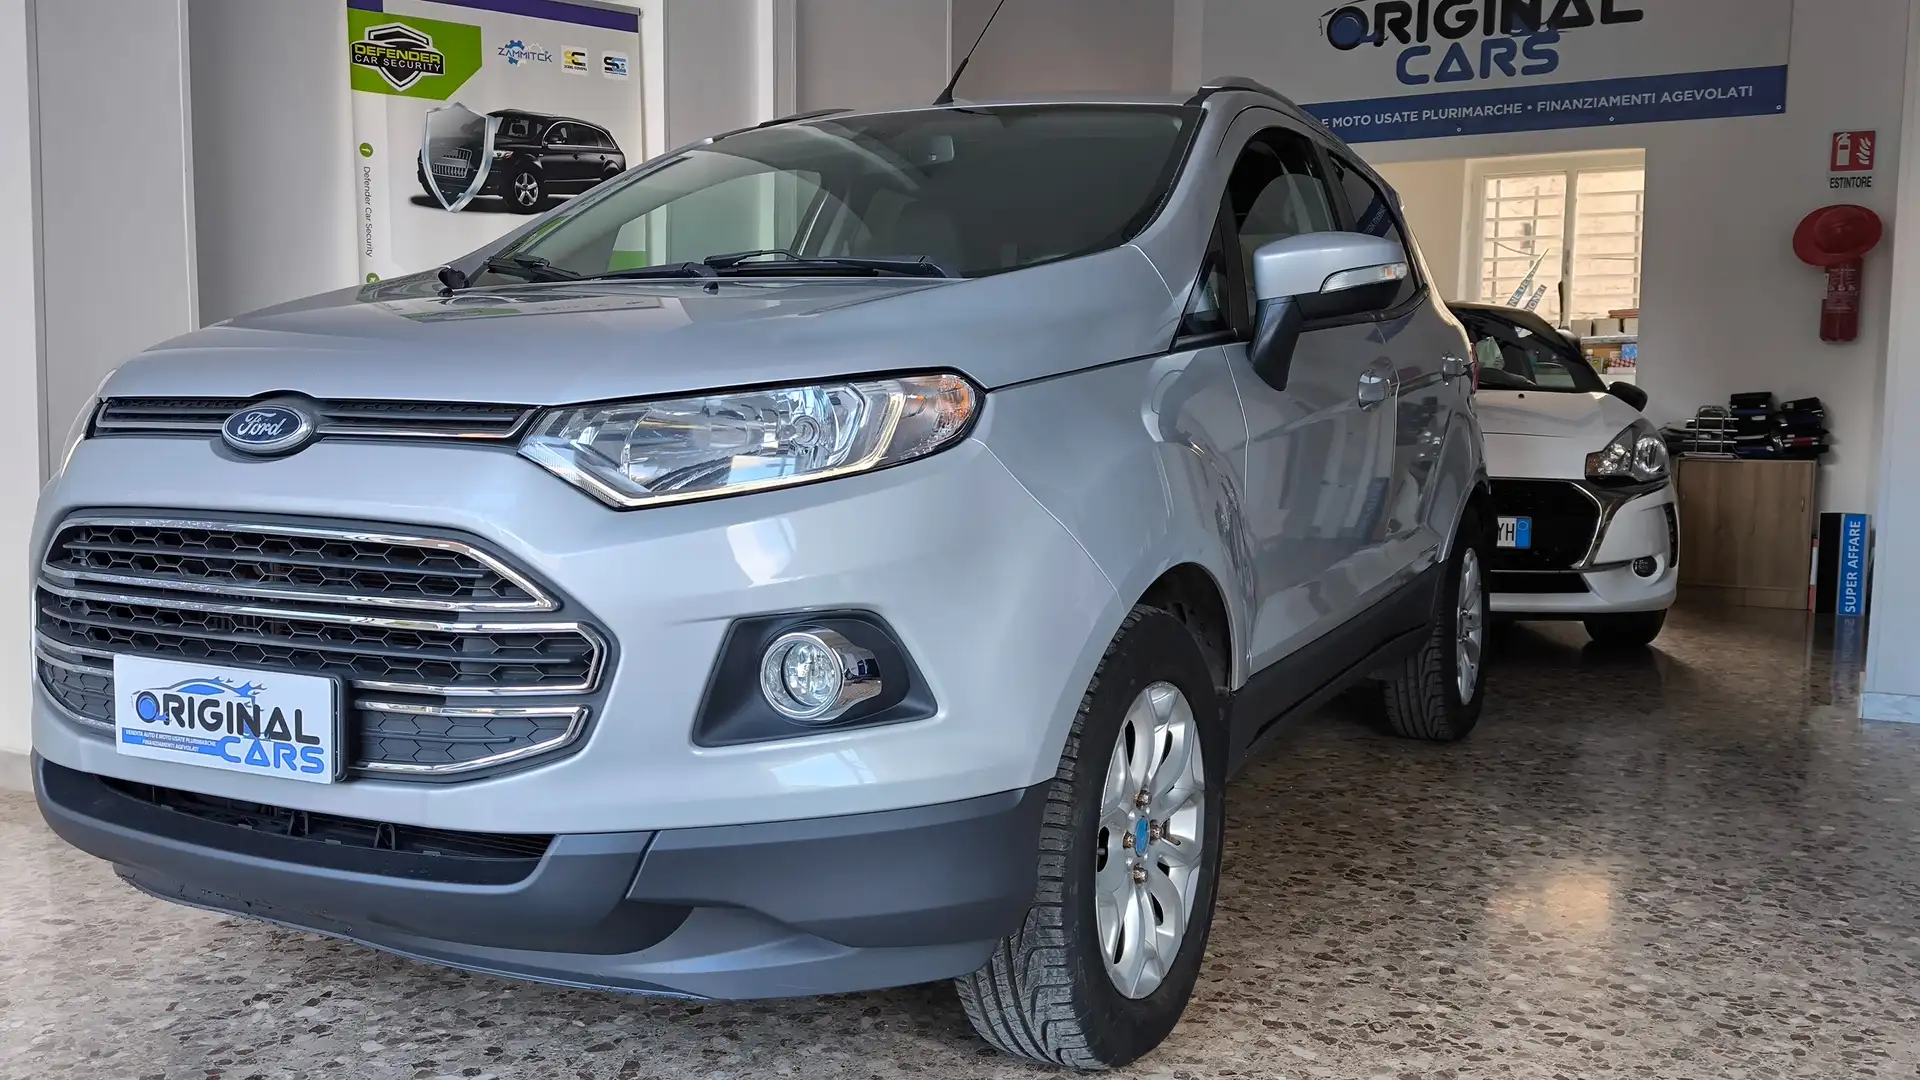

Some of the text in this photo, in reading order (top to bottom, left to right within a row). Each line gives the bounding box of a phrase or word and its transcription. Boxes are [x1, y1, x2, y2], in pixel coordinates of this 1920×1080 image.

[354, 44, 441, 64] DEFENDER
[355, 54, 441, 72] CAR SECURITY
[1396, 30, 1561, 85] CARS
[1321, 85, 1753, 128] E MOTO USATE PLURIMARCHE FINANZIAMENTI AGEVOLATI
[1829, 176, 1872, 189] ESTINTORE
[363, 166, 375, 258] Defender Car Security
[237, 411, 287, 436] Ford
[1845, 521, 1861, 613] SUPER AFFARE
[136, 691, 320, 745] ORIGINAL
[222, 736, 324, 774] CARS
